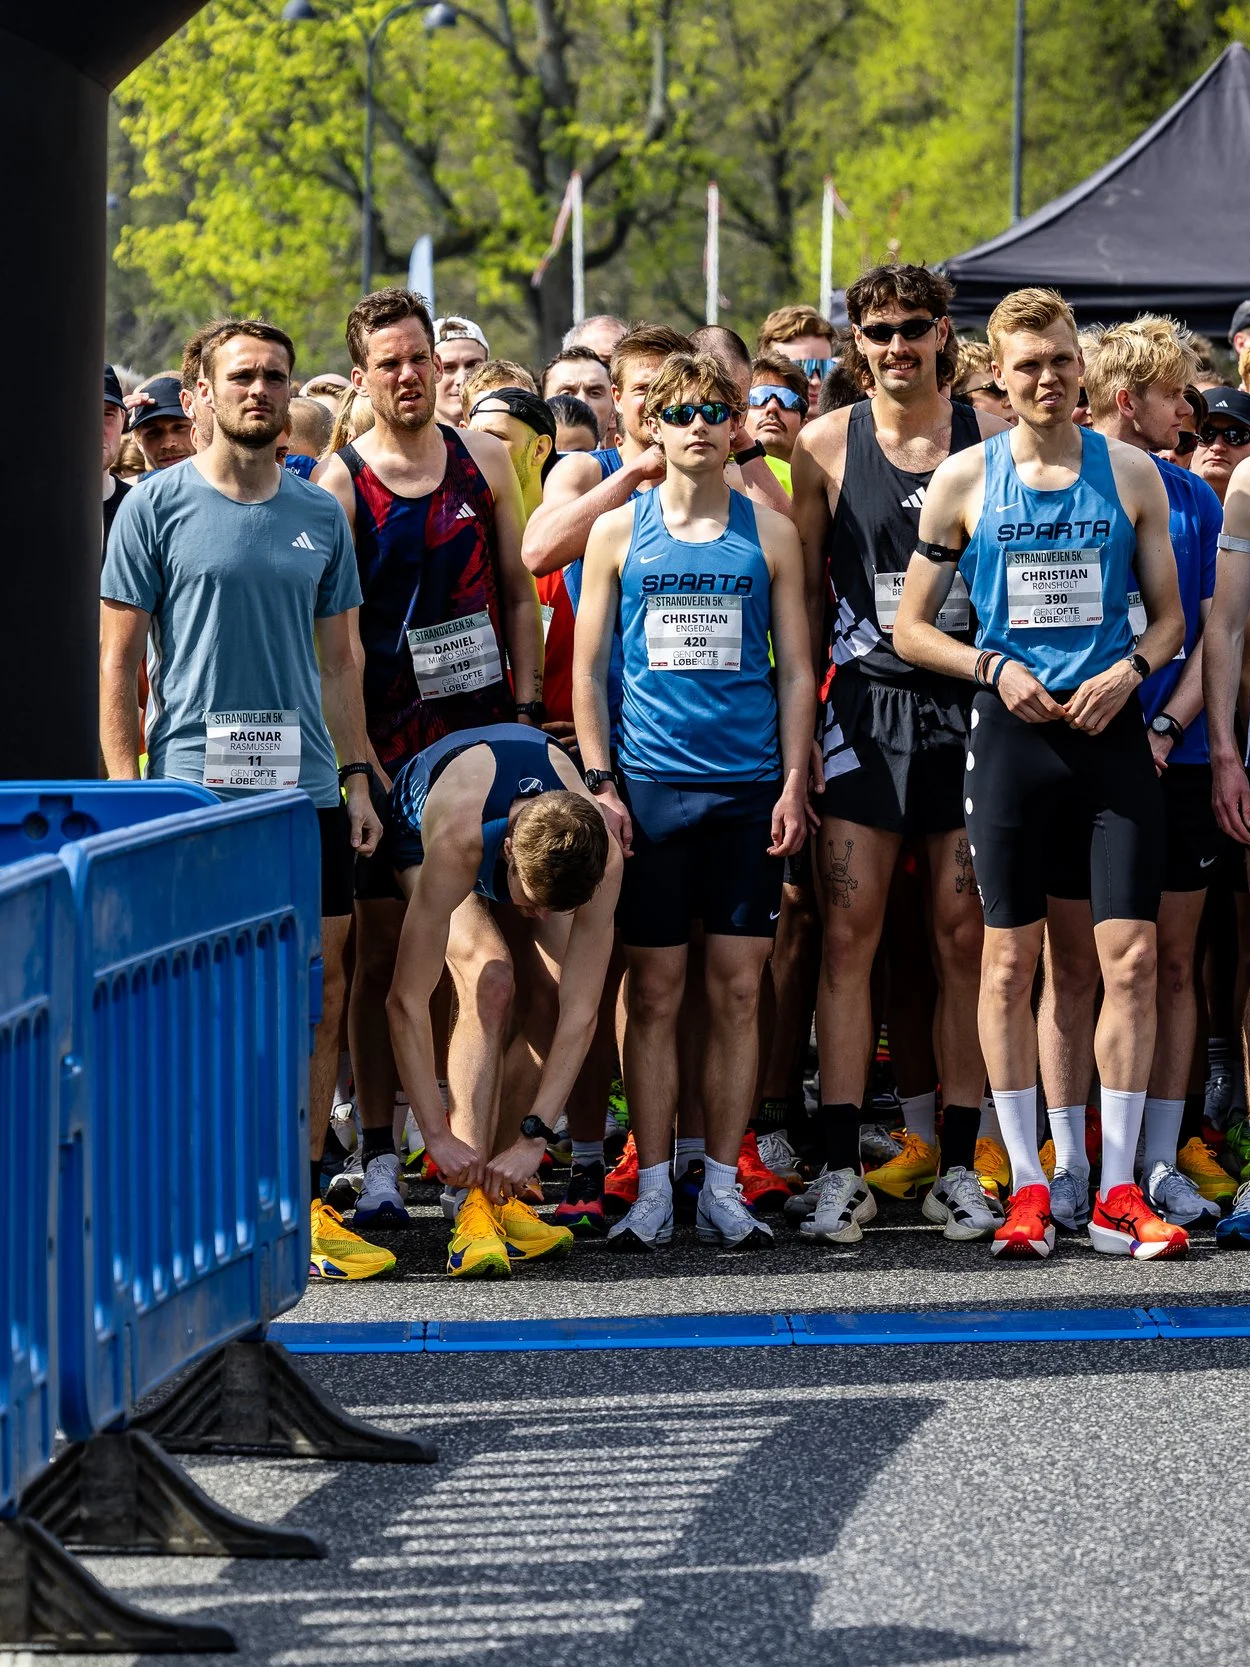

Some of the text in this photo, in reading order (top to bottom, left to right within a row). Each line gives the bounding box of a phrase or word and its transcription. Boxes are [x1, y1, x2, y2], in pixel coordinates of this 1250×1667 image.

[997, 519, 1110, 542] SPARTA
[1015, 550, 1082, 564] STRANDVEJEN 5K
[1022, 569, 1088, 581] CHRISTIAN
[642, 573, 753, 593] SPARTA
[1032, 581, 1078, 590] RØNSHOLT
[656, 596, 723, 607] STRANDVEJEN 5K
[1044, 594, 1068, 604] 390
[1034, 607, 1080, 616] GENTOFTE
[662, 614, 728, 624] CHRISTIAN
[1034, 615, 1080, 624] LØBEKLUB
[415, 617, 476, 641] STRANDVEJEN 5K
[675, 624, 715, 632] ENGEDAL
[434, 636, 475, 654] DANIEL
[684, 637, 707, 647] 420
[428, 652, 454, 664] MIKKO
[456, 643, 484, 658] SIMONY
[673, 650, 719, 658] GENTOFTE
[450, 660, 470, 674] 119
[673, 658, 719, 666] LØBEKLUB
[442, 669, 483, 686] GENTOFTE
[443, 677, 486, 693] LØBEKLUB
[215, 712, 283, 724] STRANDVEJEN 5K
[230, 731, 282, 742] RAGNAR
[230, 742, 280, 751] RASMUSSEN
[248, 755, 262, 766] 11
[230, 769, 277, 778] GENTOFTE
